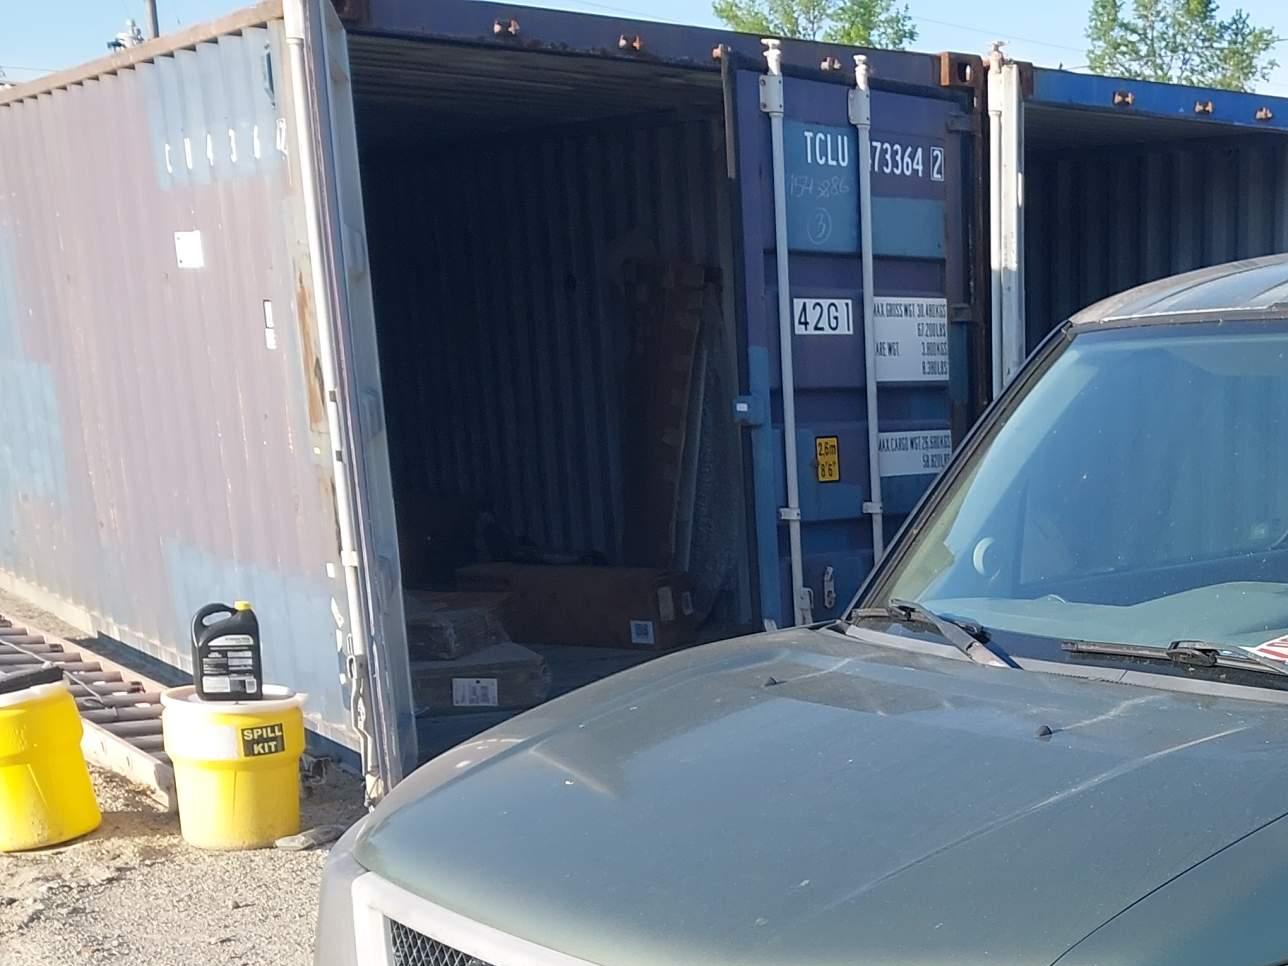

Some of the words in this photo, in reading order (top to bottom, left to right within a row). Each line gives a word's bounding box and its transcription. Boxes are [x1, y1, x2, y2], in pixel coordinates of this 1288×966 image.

[804, 131, 848, 167] TCLU
[869, 141, 923, 177] 73364
[932, 149, 942, 178] 2
[798, 301, 852, 333] 42G1
[243, 725, 282, 741] SPILL
[253, 740, 277, 755] KIT
